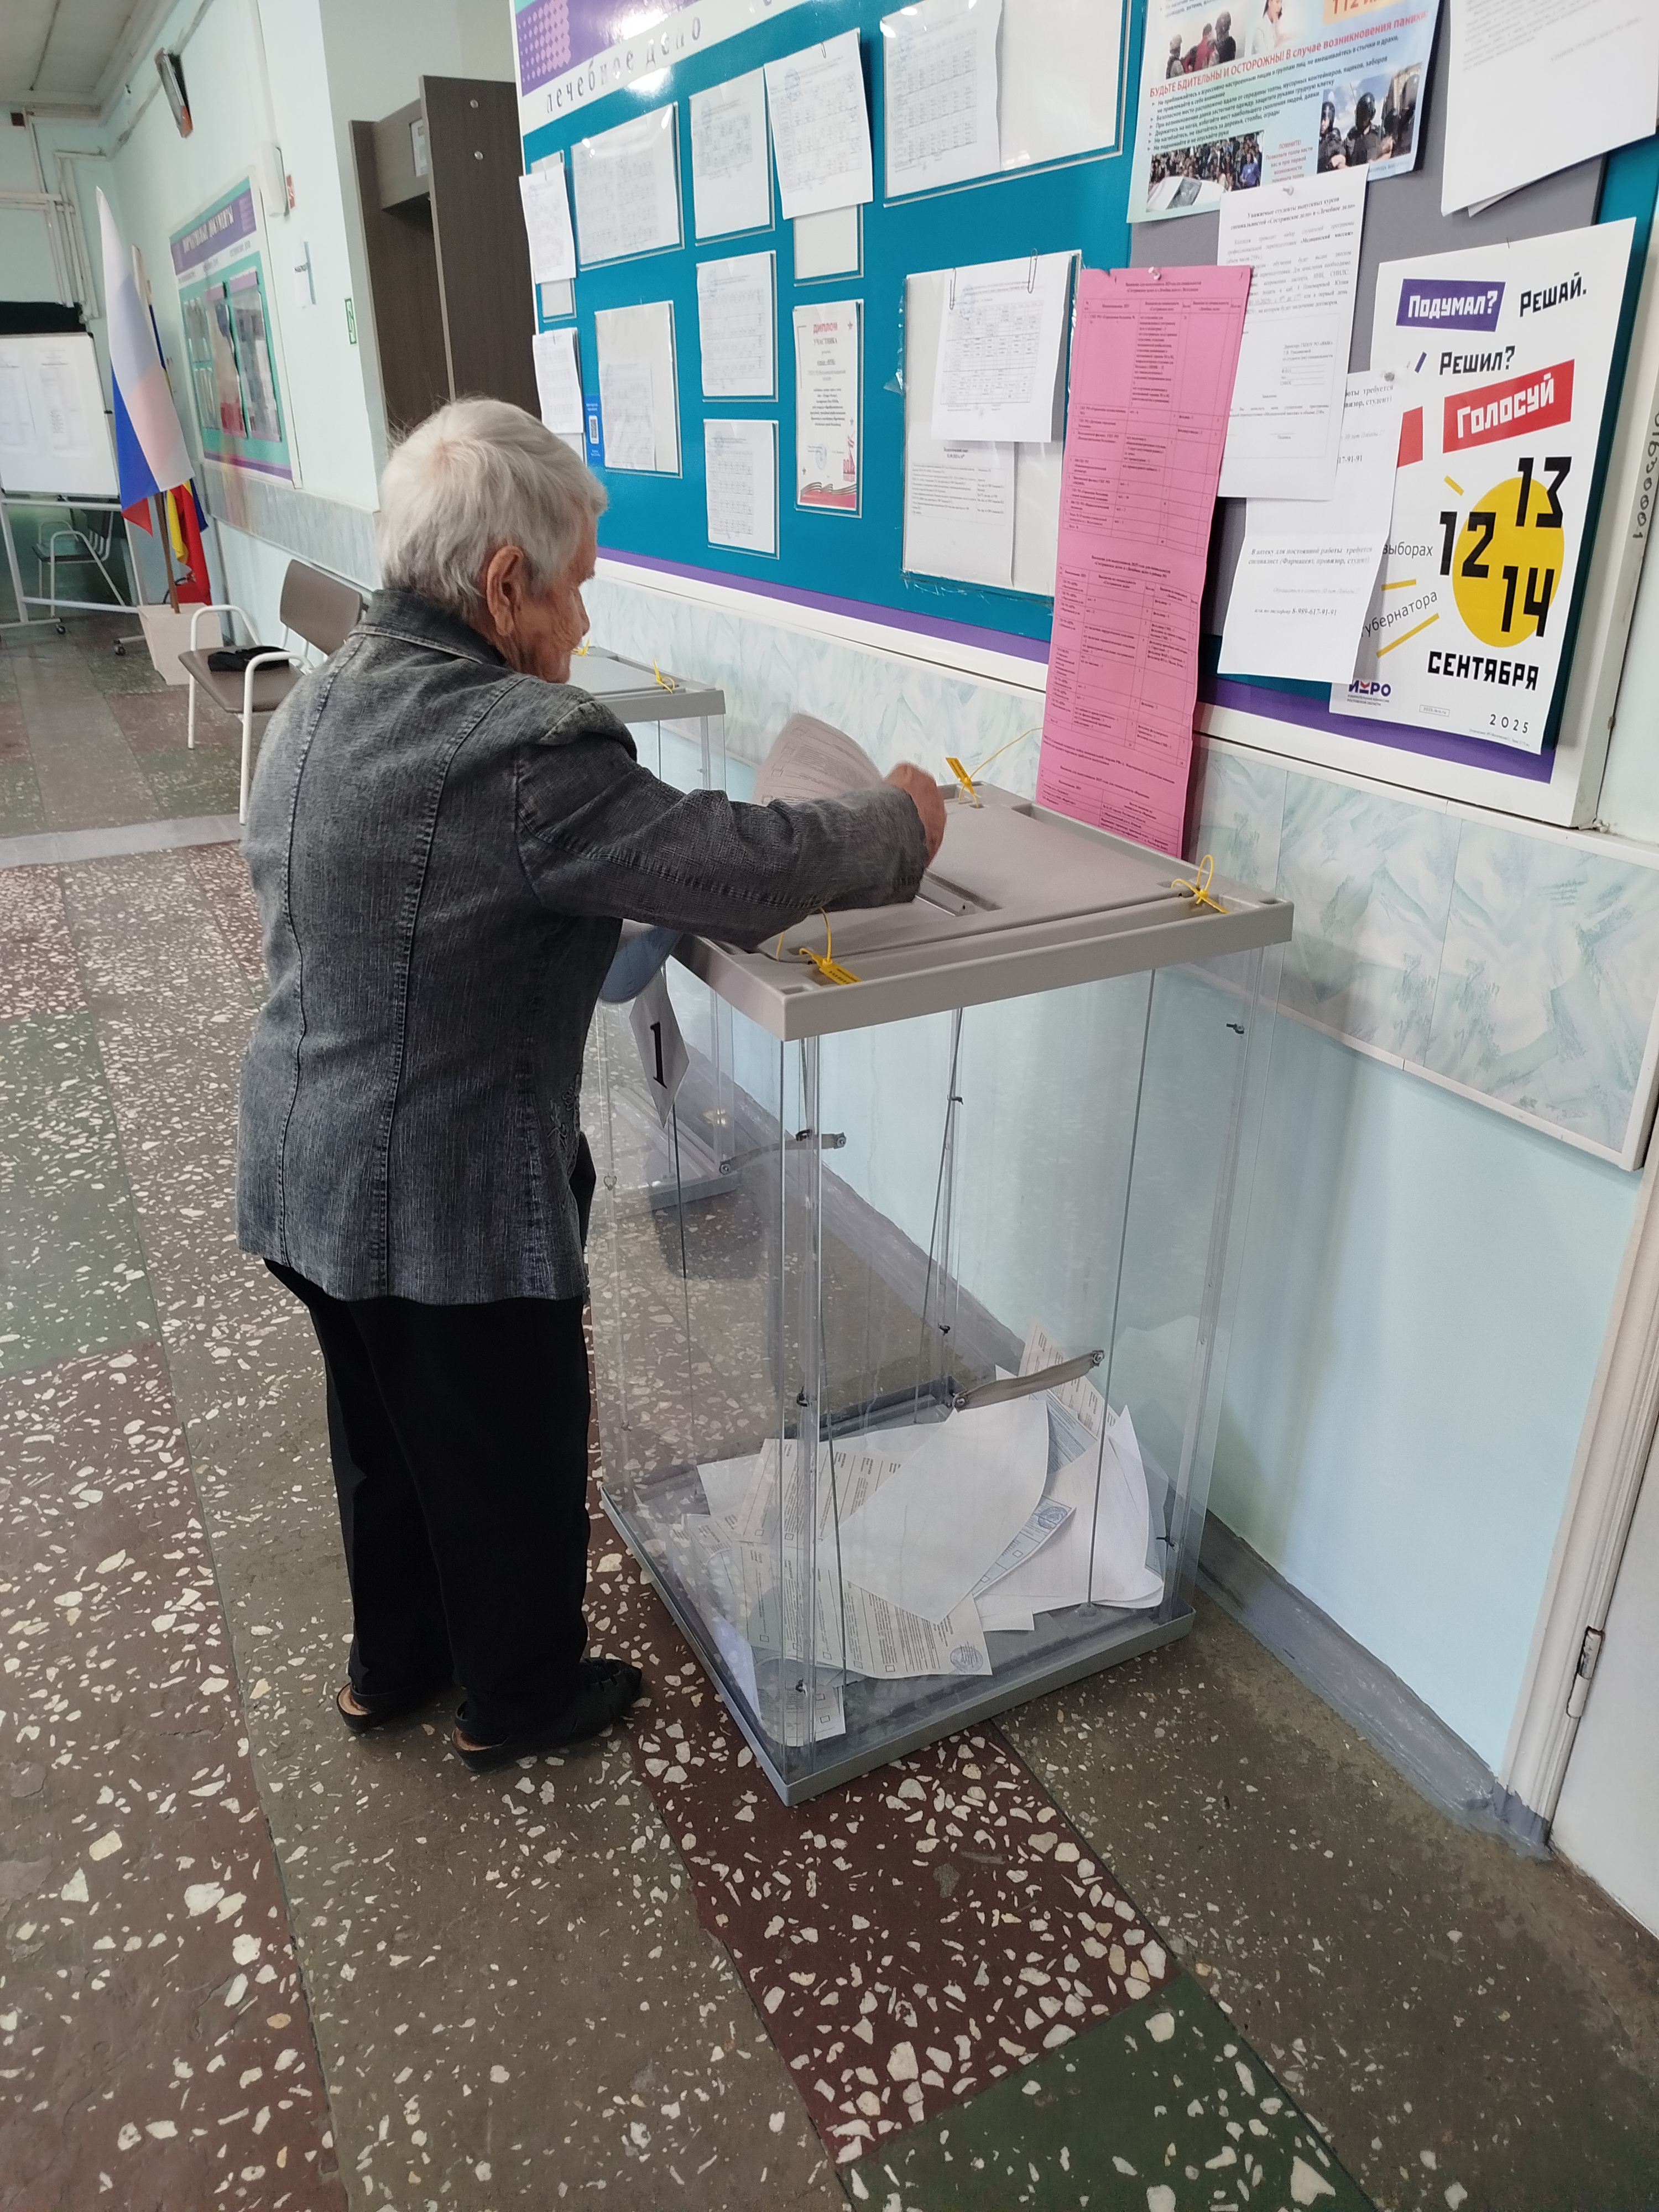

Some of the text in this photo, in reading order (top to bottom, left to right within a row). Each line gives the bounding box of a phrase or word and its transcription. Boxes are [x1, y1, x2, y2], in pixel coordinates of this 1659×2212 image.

[1150, 82, 1176, 97] БУДЬТЕ
[1177, 72, 1222, 90] БДИТЕЛЬНЫ
[1223, 68, 1229, 78] И
[1231, 54, 1284, 75] ОСТОРОЖНЫ!
[1286, 49, 1291, 60] В
[1293, 43, 1321, 59] случае
[1323, 22, 1391, 49] возникновения
[813, 322, 838, 335] ДИПЛОМ
[1338, 455, 1362, 463] 17-91-91
[1515, 456, 1572, 528] 13
[1383, 541, 1433, 559] выборах
[1439, 511, 1496, 578] 12
[1501, 565, 1554, 637] 14
[1427, 650, 1540, 691] СЕНТЯБРЯ
[650, 1021, 667, 1089] 1
